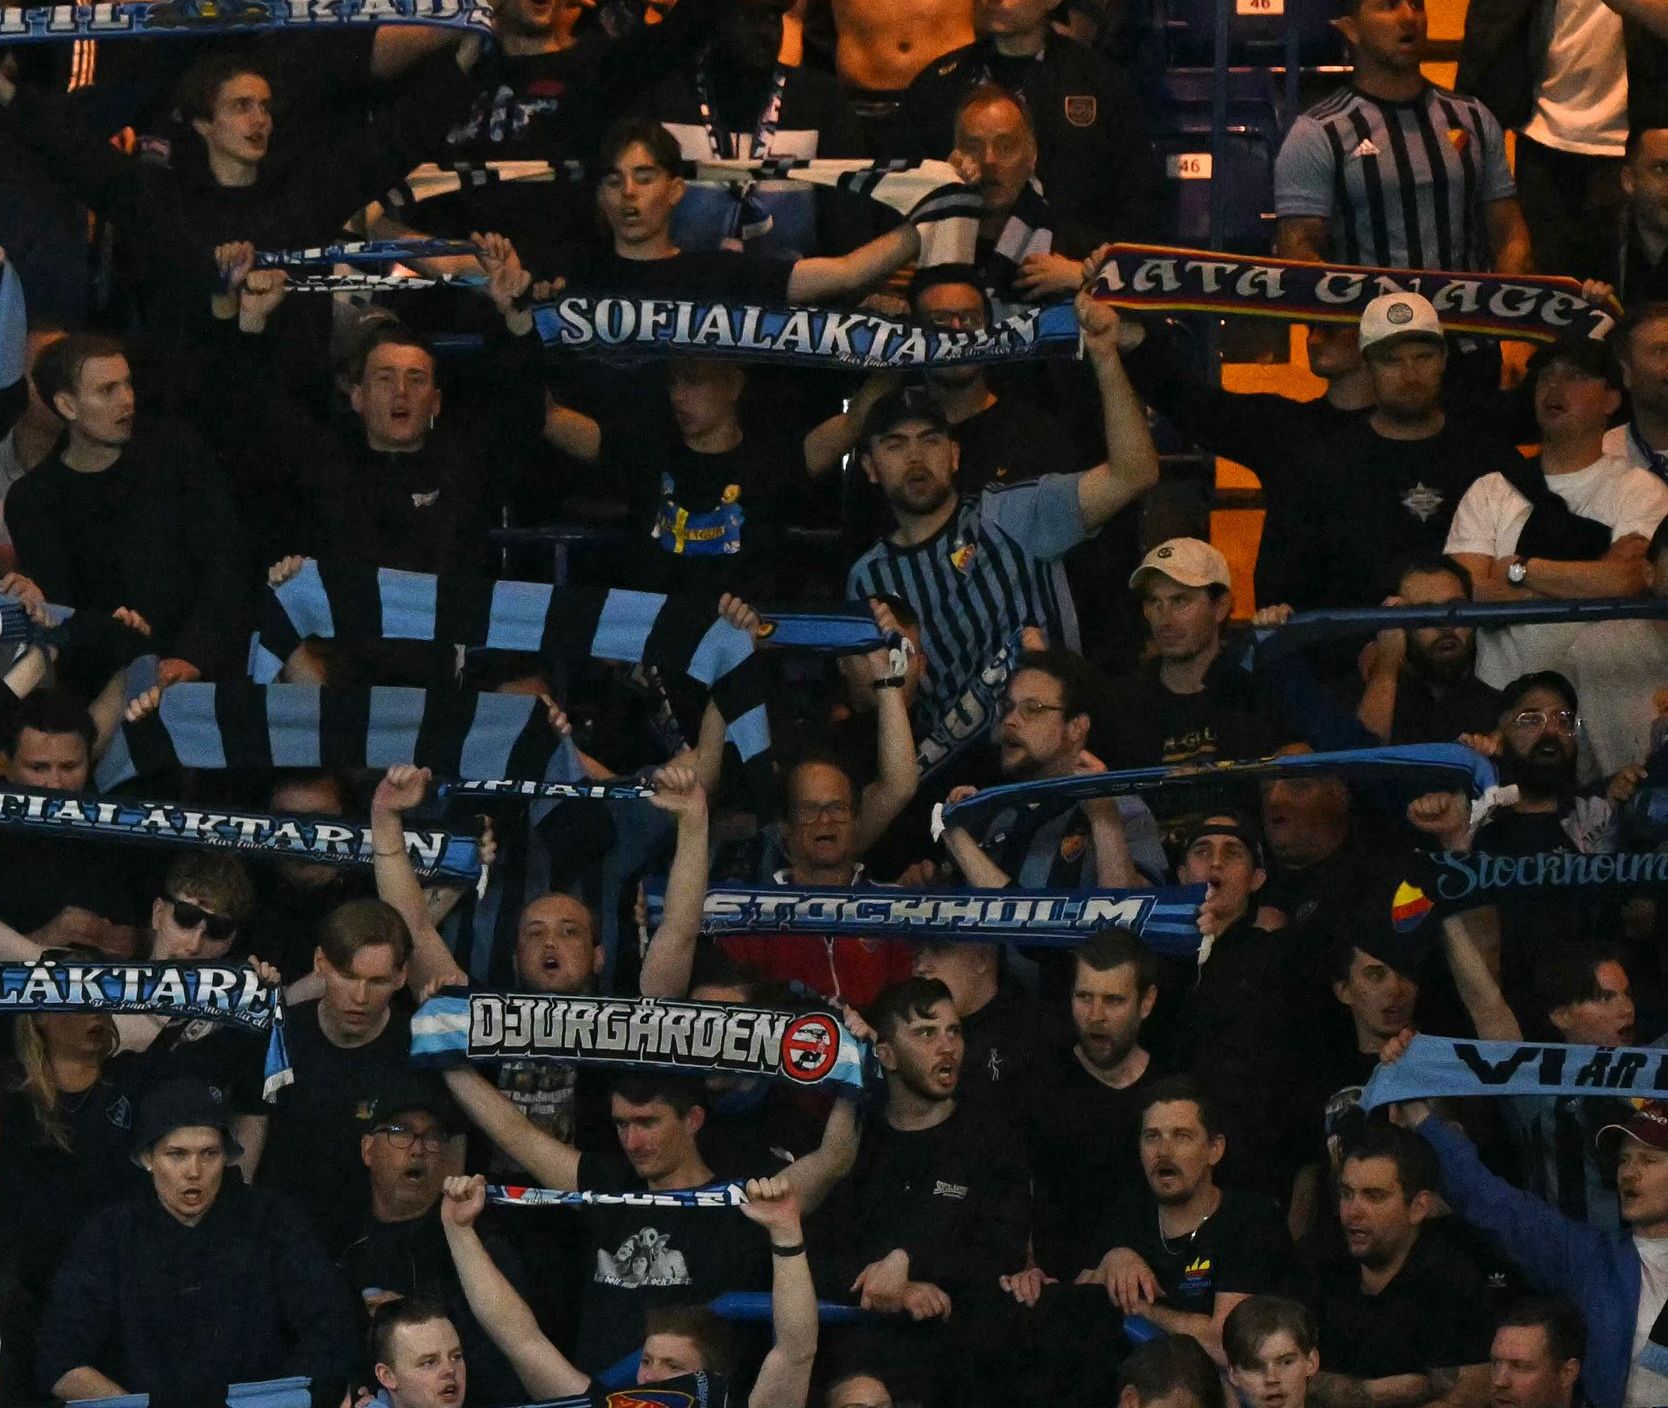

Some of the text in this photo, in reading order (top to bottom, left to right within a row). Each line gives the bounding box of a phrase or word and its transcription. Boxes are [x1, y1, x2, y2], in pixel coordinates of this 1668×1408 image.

[1179, 159, 1201, 174] 46
[471, 995, 790, 1076] DJURGÅRDEN
[1451, 1042, 1564, 1087] VI
